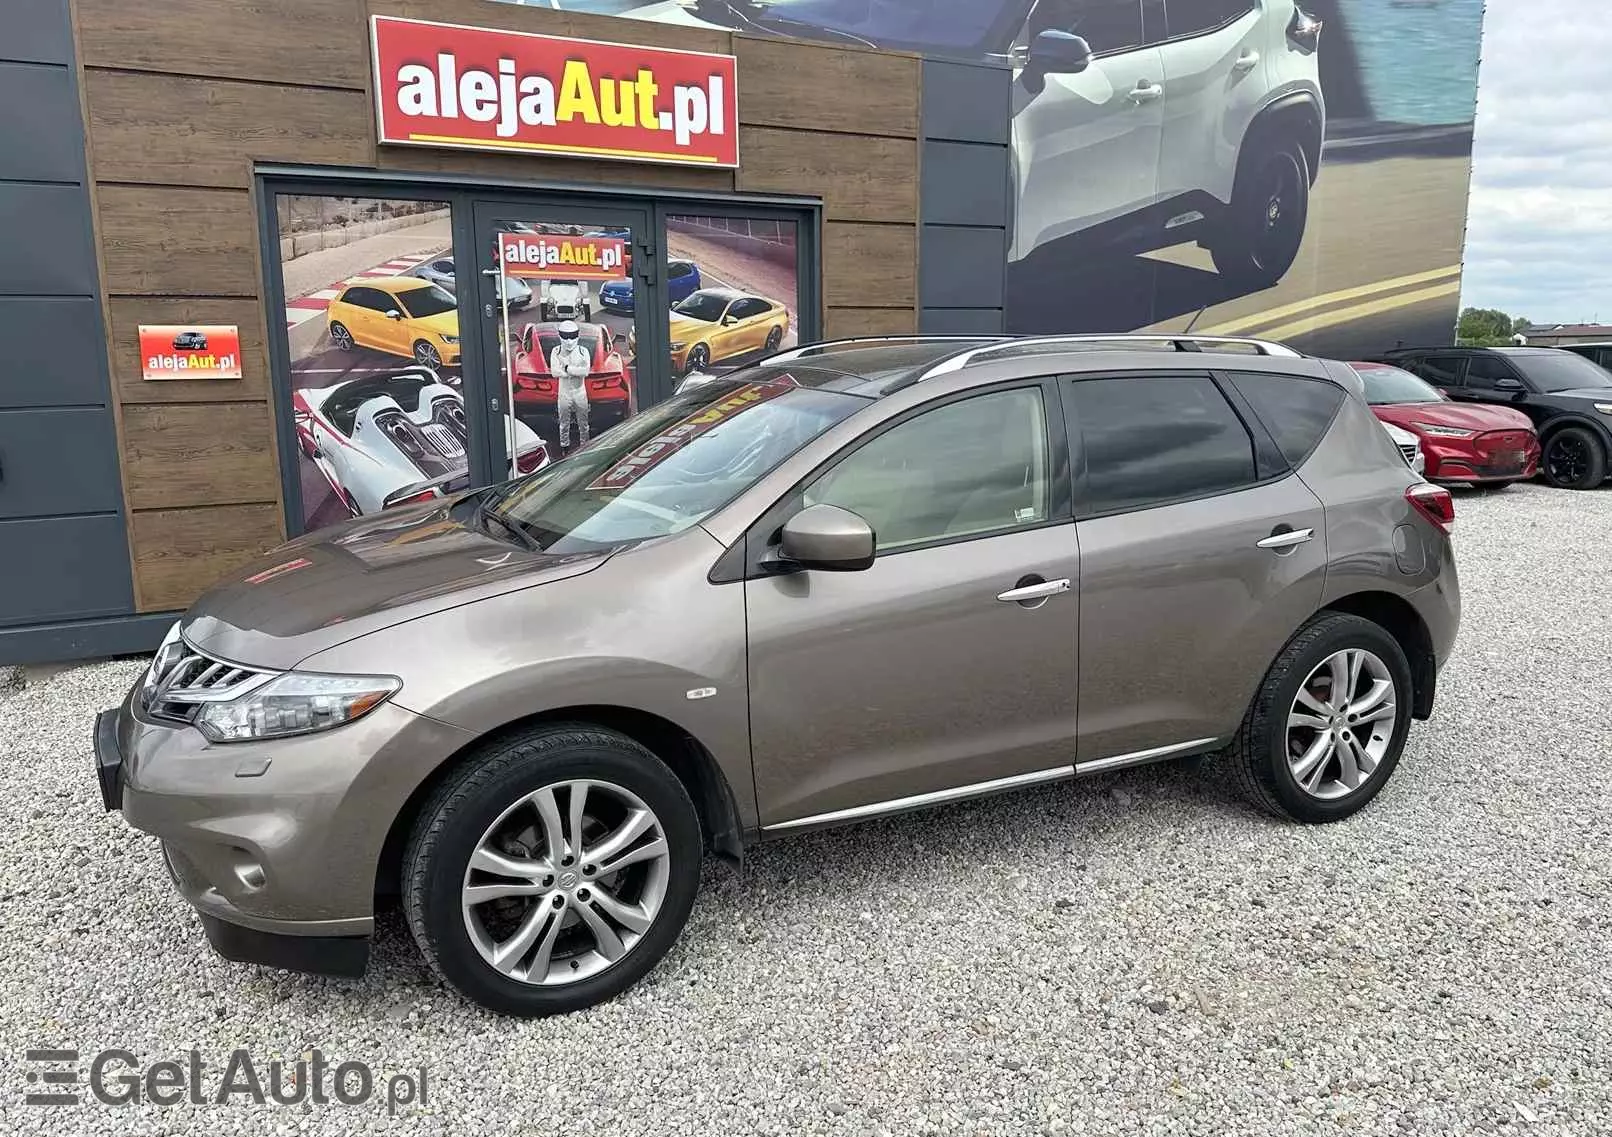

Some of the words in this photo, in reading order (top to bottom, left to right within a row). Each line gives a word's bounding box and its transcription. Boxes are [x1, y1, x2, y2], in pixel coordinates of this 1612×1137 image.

[397, 52, 724, 145] alejaAut.pl
[505, 239, 621, 270] alejaAut.pl
[148, 353, 235, 372] alejaAut.pl
